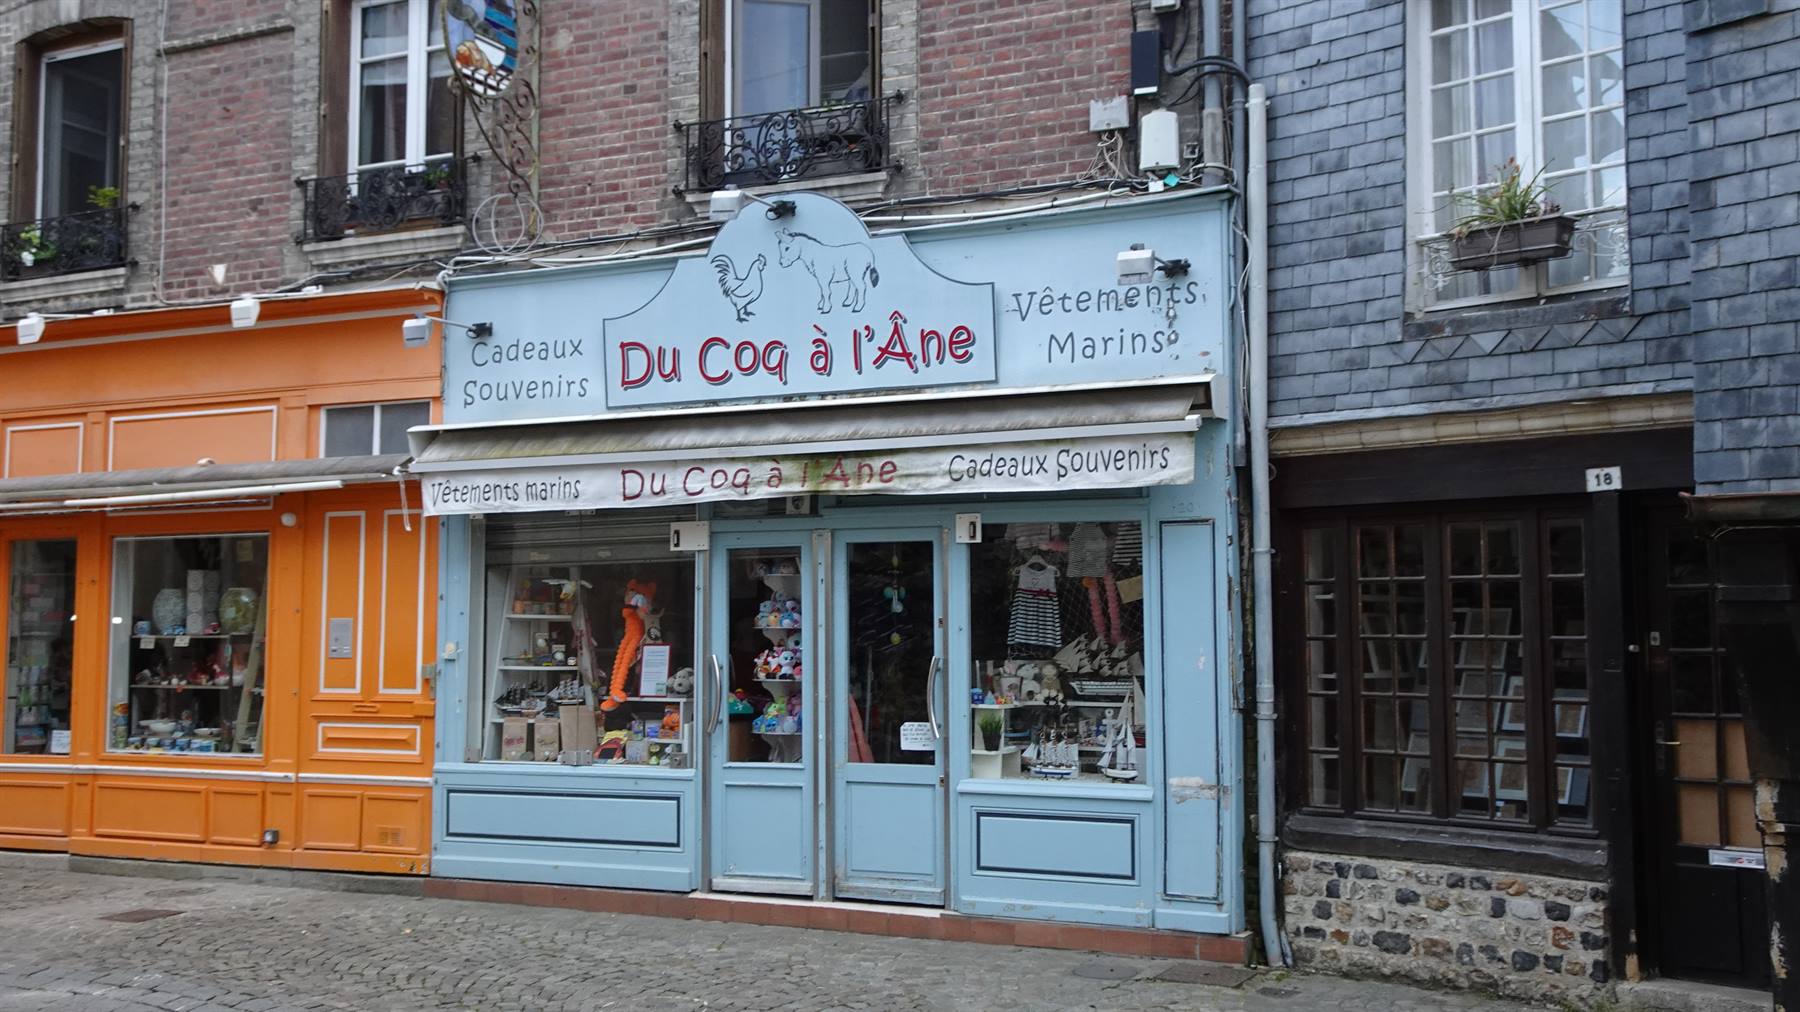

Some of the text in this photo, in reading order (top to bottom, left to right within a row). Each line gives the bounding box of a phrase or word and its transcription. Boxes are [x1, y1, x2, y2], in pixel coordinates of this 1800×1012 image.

[1013, 281, 1198, 321] Vêtements
[471, 338, 584, 367] Cadeaux
[619, 311, 977, 390] Du Coq à l'Âne
[1048, 328, 1165, 363] Marins
[464, 375, 590, 409] Souvenirs
[620, 469, 667, 501] Du
[683, 466, 751, 496] Coq
[767, 458, 783, 488] à
[949, 443, 1171, 482] Cadeaux Souvenirs
[1594, 472, 1613, 487] 18
[431, 476, 581, 507] Vêtements marins
